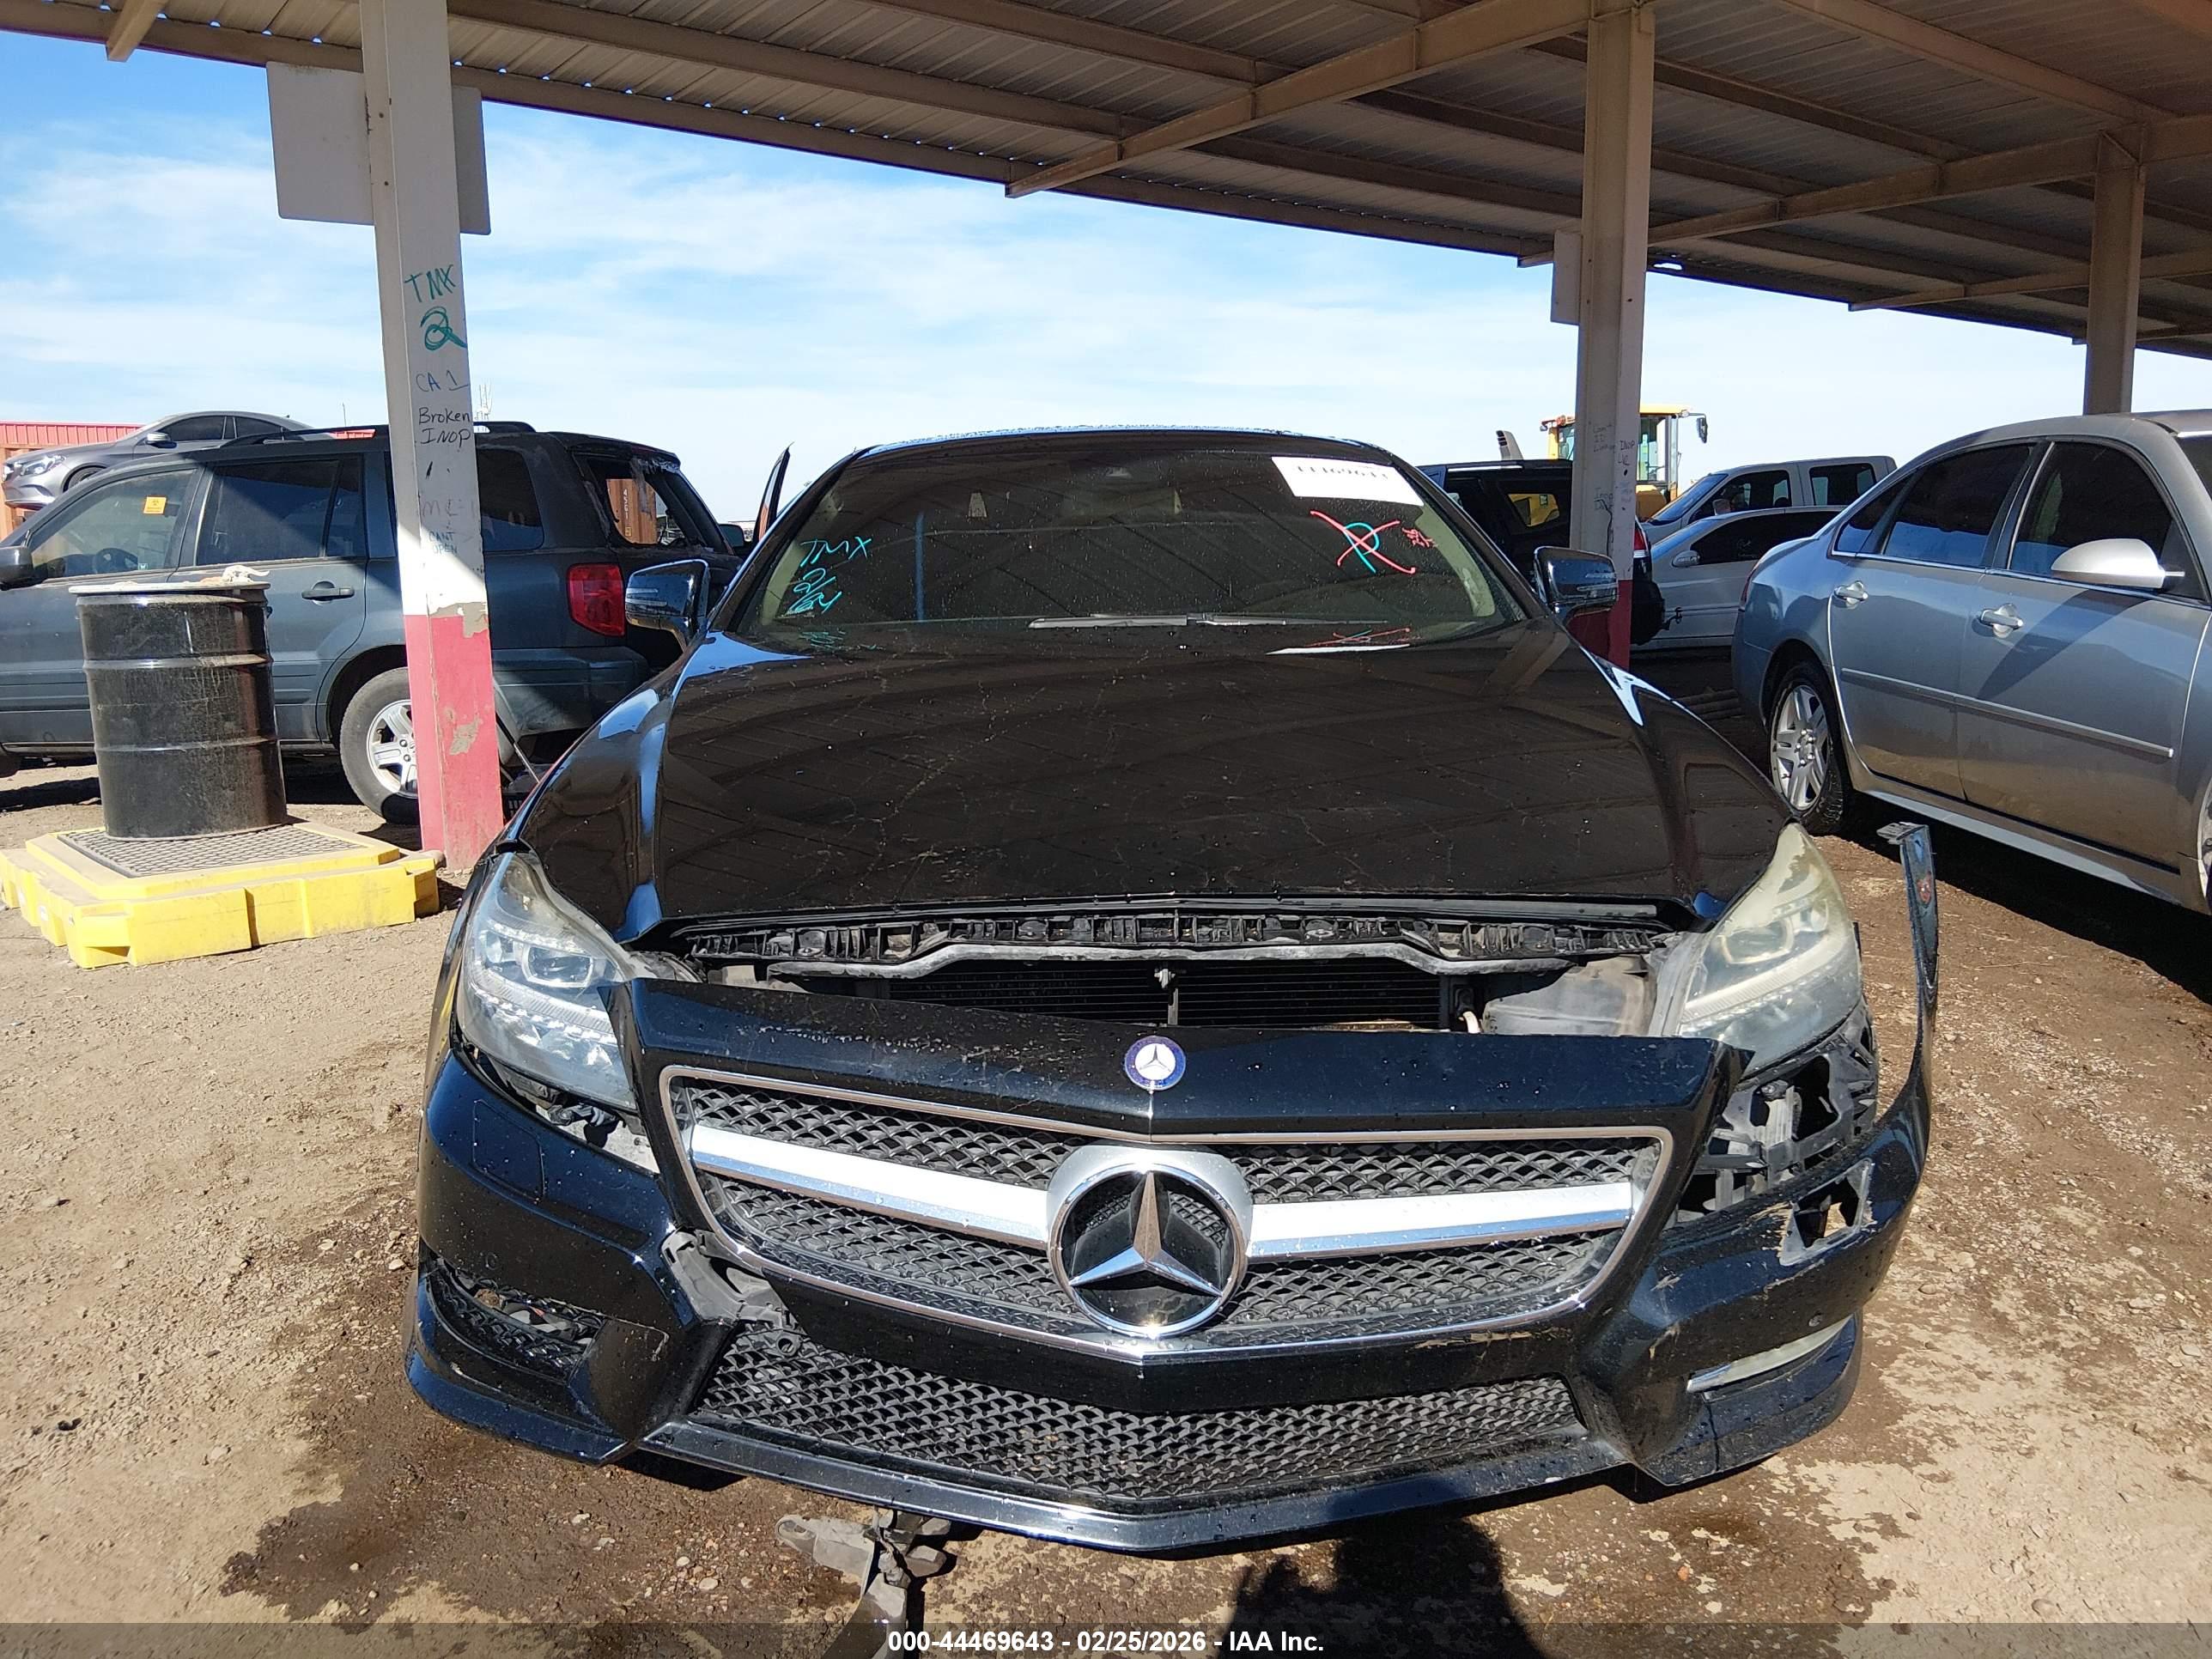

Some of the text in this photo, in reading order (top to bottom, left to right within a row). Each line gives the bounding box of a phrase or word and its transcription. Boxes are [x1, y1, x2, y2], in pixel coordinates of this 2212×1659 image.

[404, 264, 457, 303] TMX
[420, 306, 468, 351] 2
[418, 406, 471, 425] Broken
[420, 428, 471, 448] INOP
[800, 536, 872, 568] TMX
